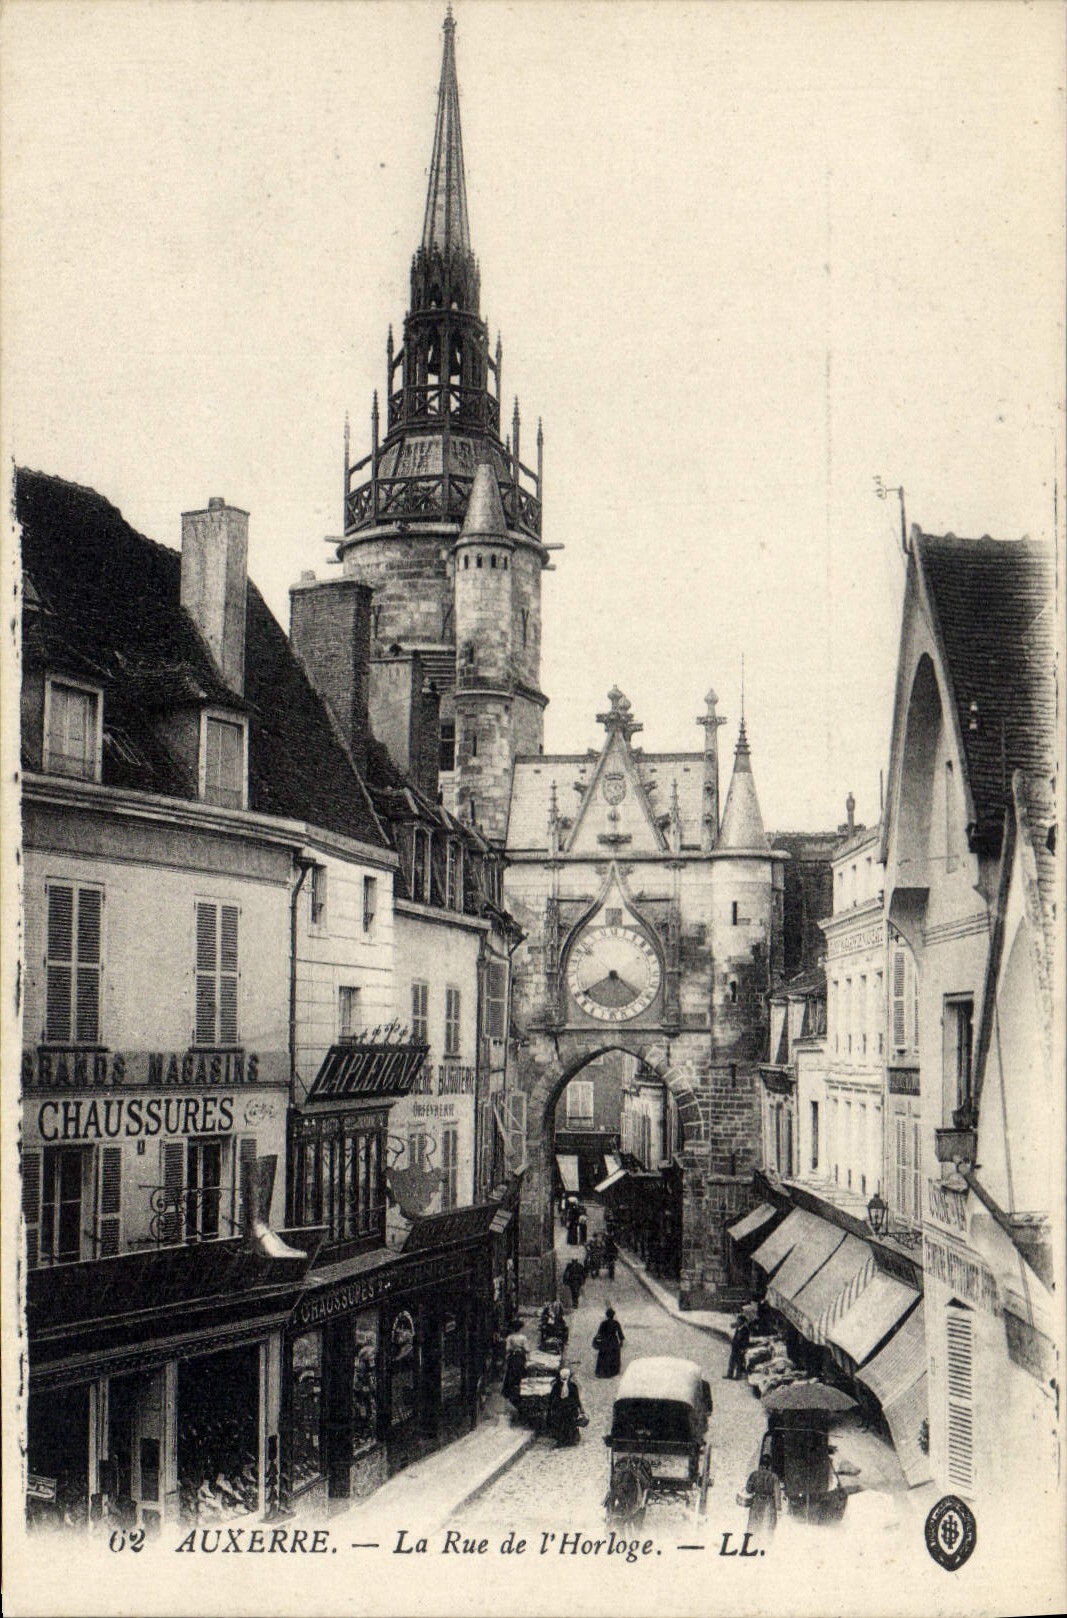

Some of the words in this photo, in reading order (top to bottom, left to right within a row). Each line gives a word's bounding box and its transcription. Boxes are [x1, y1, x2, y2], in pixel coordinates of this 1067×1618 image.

[148, 1052, 259, 1084] MAGASINS
[313, 1052, 425, 1095] LAPLEIGNE
[38, 1097, 234, 1142] CHAUSSURES
[300, 1279, 375, 1323] CHAUSSURES
